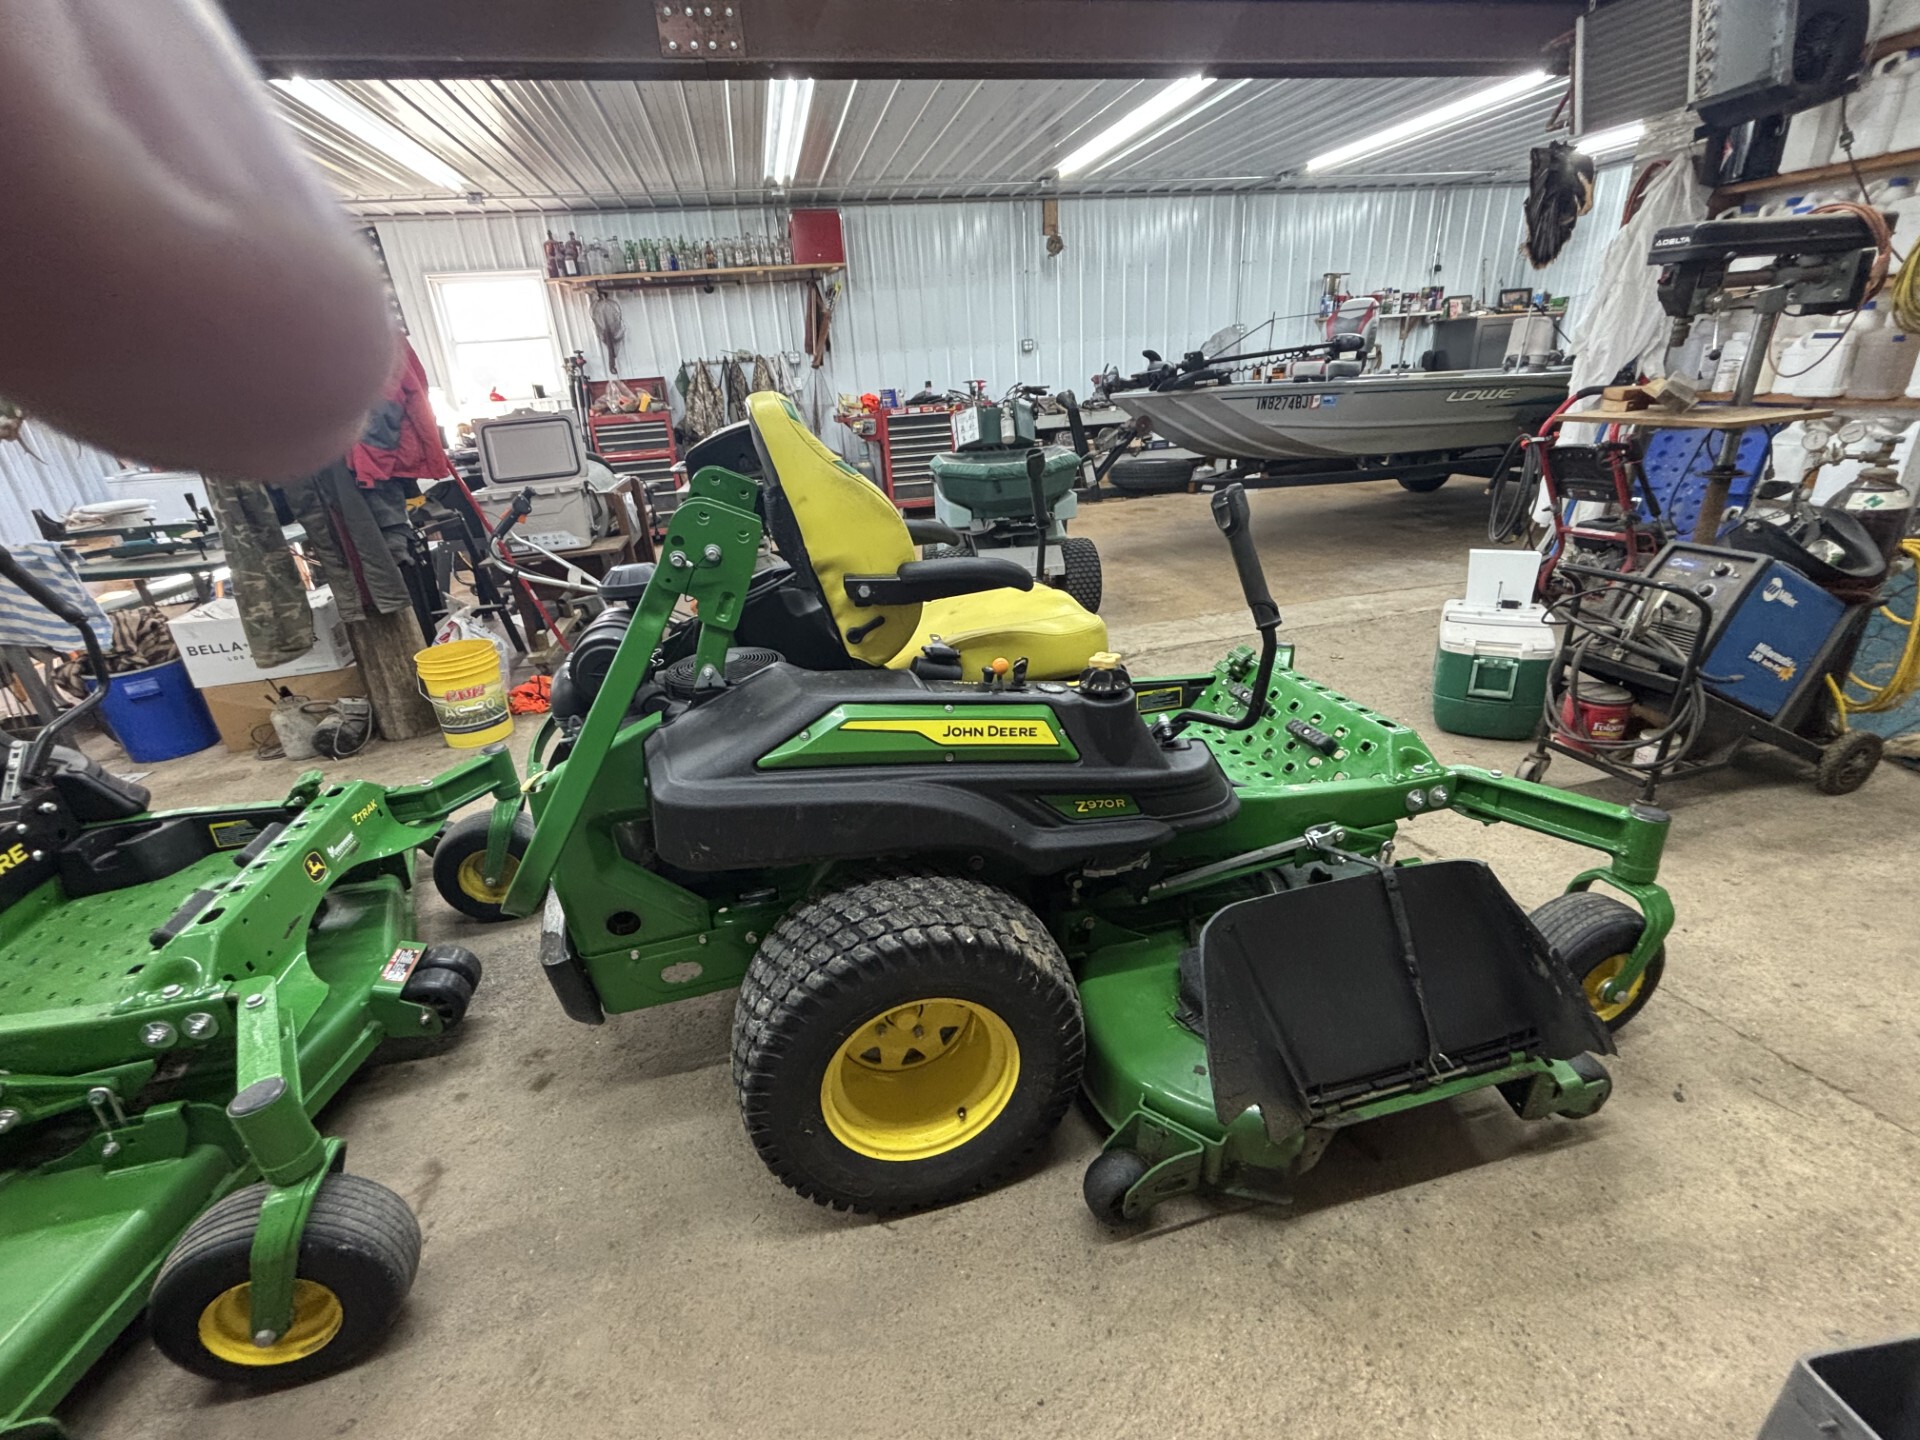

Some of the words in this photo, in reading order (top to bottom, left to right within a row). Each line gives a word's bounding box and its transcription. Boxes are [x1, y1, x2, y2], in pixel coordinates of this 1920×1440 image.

[1446, 388, 1520, 402] LOWE
[943, 725, 984, 737] JOHN
[987, 725, 1038, 737] DEERE
[1075, 798, 1126, 813] Z970R
